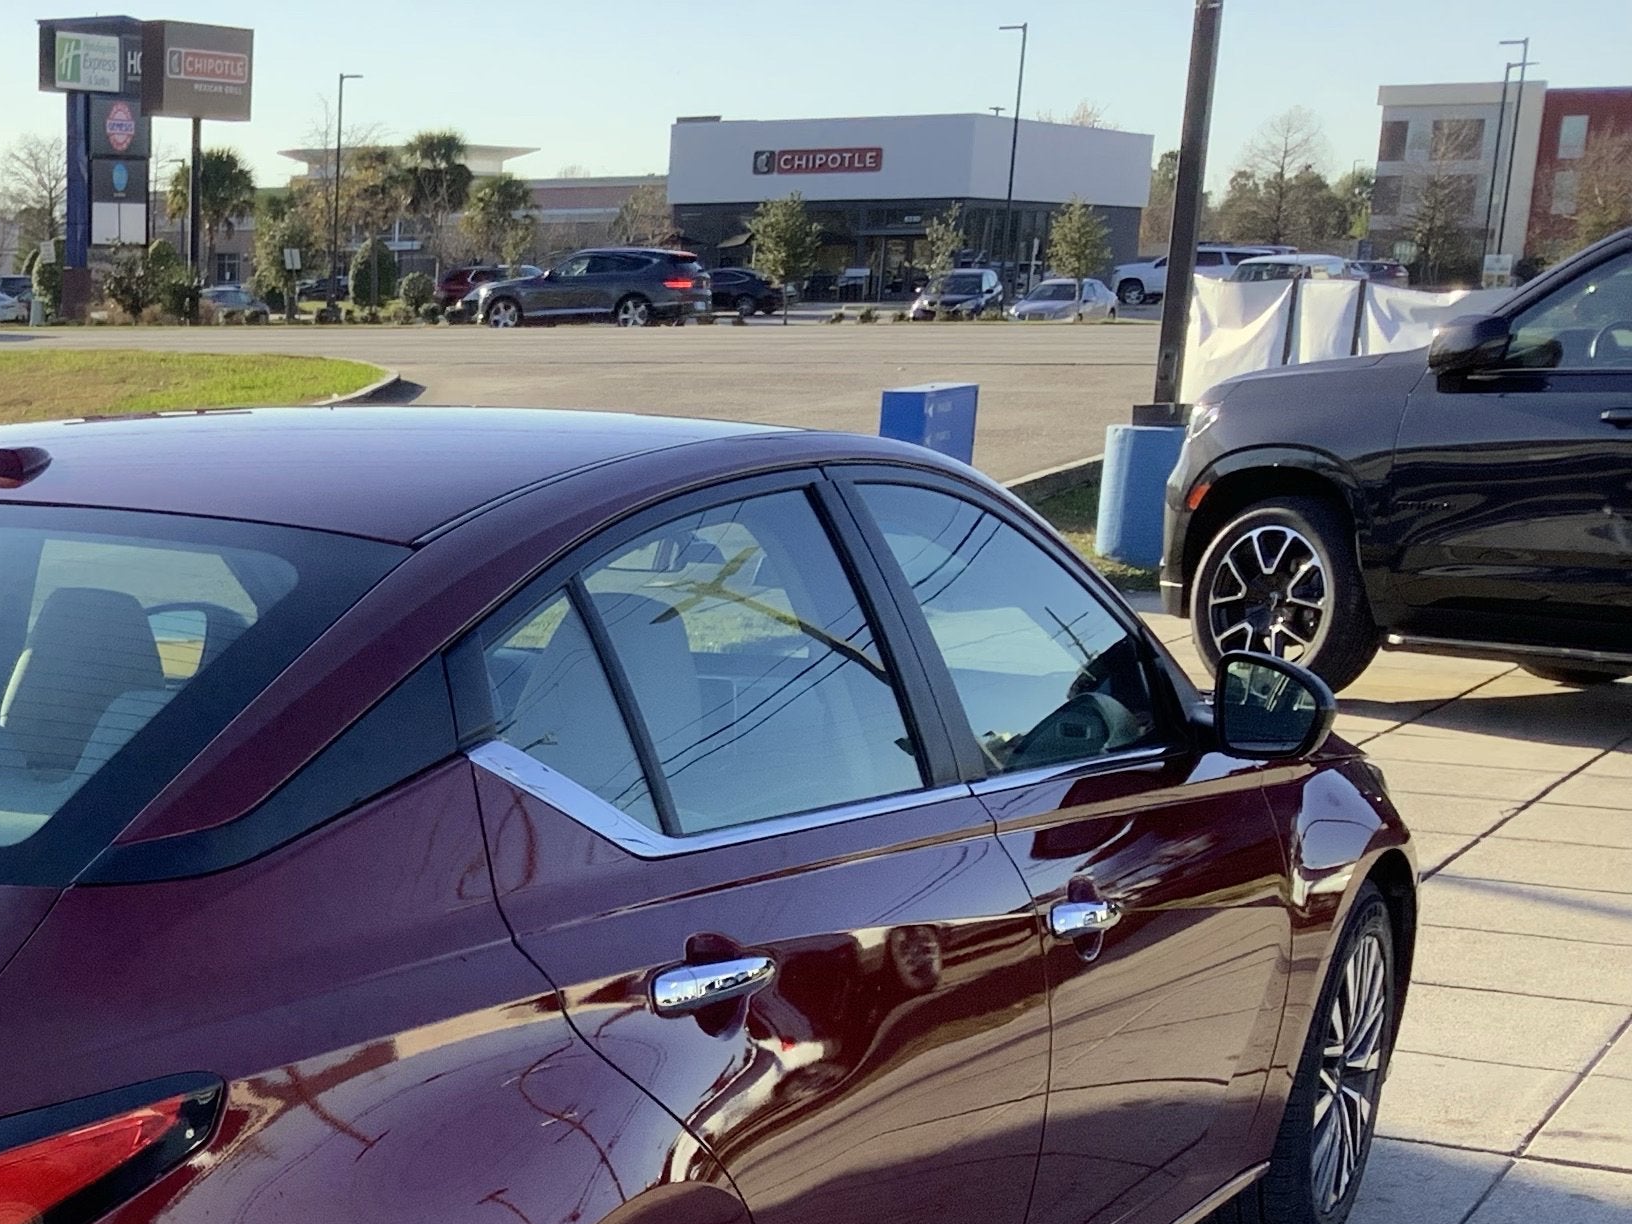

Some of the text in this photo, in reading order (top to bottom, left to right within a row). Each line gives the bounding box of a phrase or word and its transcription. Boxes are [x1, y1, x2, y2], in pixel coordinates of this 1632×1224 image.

[83, 52, 116, 73] Express
[185, 56, 244, 76] CHIPOTLE
[779, 151, 877, 169] CHIPOTLE
